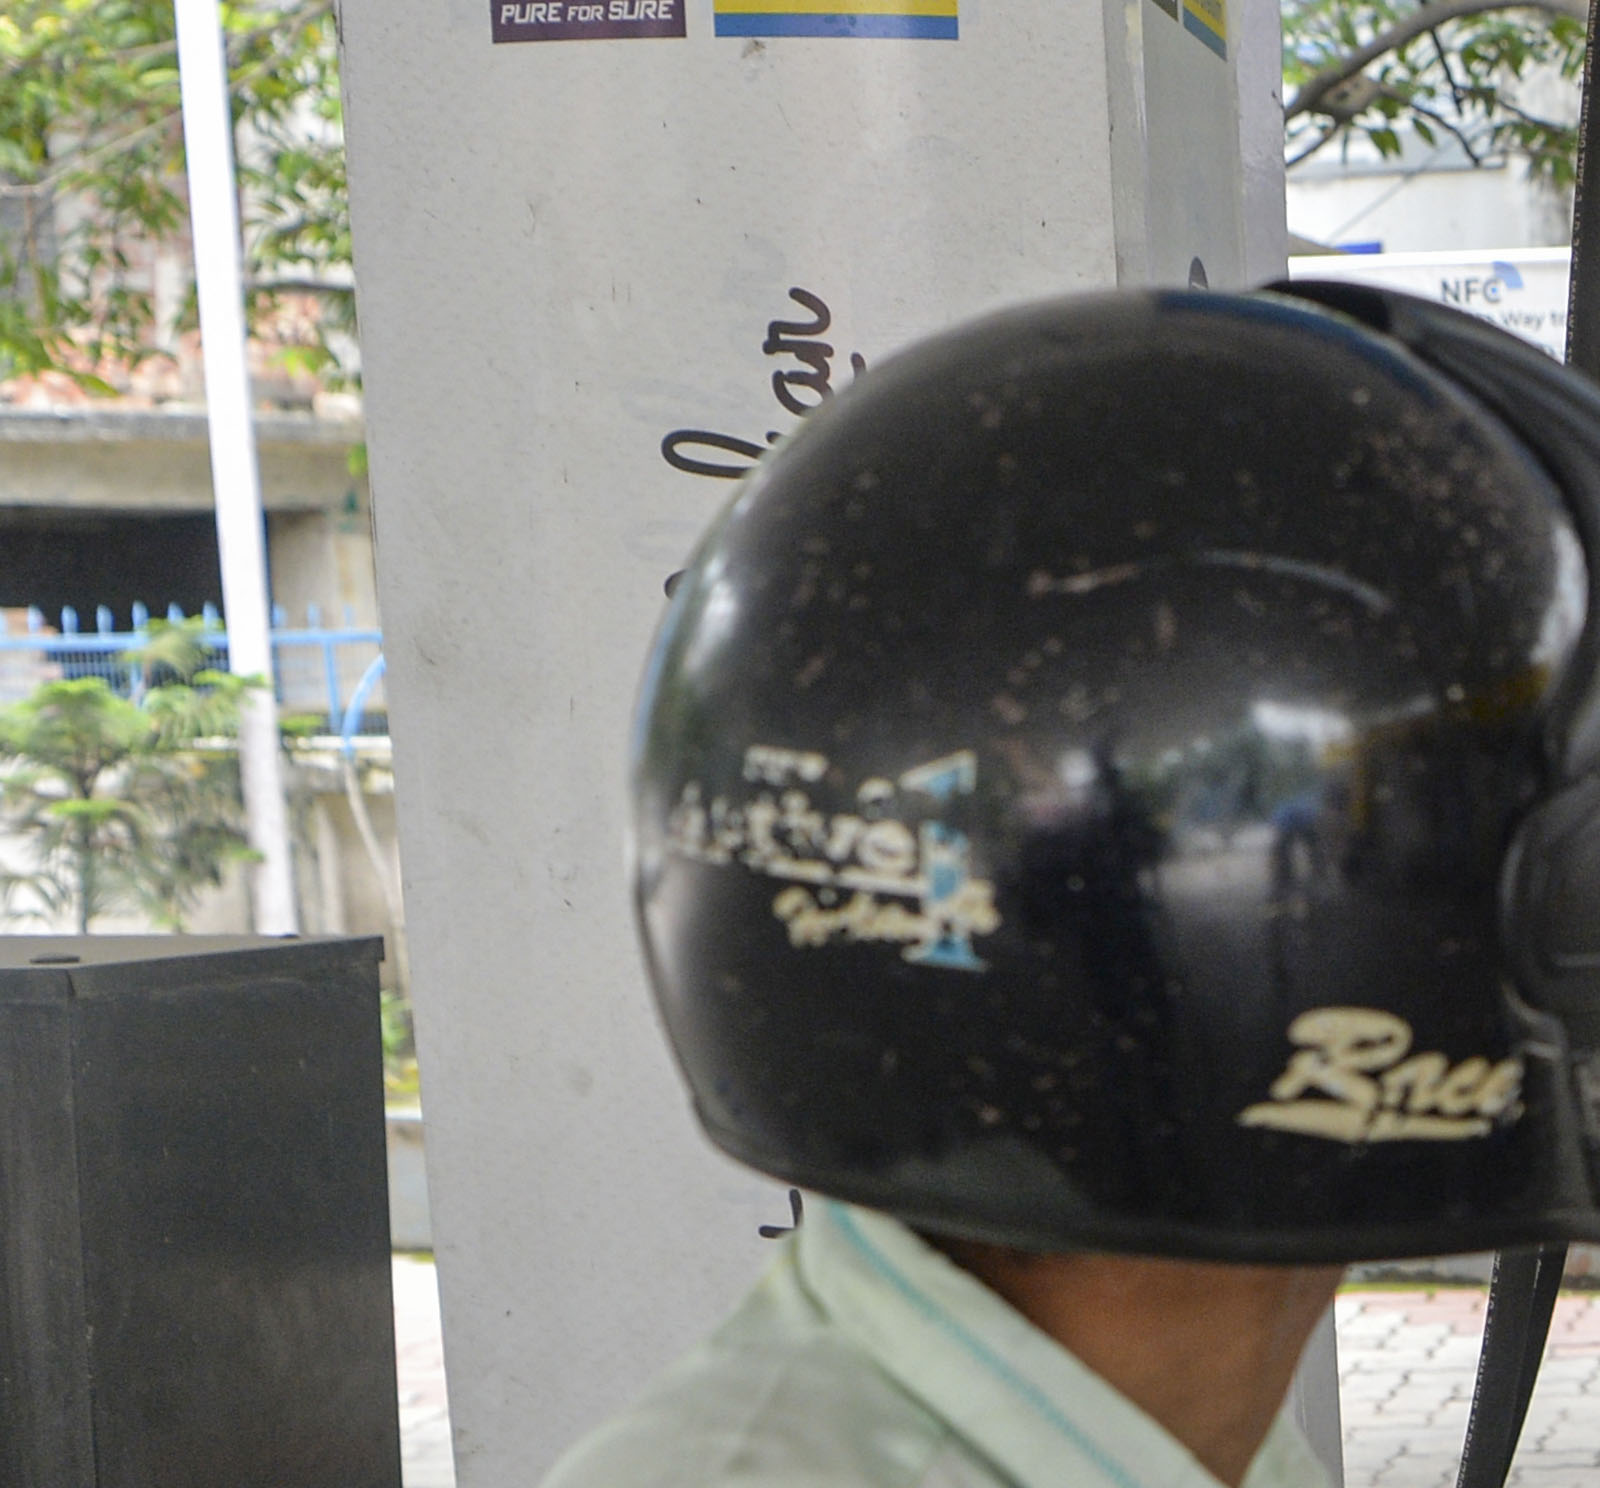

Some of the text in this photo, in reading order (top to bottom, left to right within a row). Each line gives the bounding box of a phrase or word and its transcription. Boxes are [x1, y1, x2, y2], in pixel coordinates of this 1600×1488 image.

[500, 0, 673, 24] PURE FOR SURE
[1440, 277, 1503, 303] NFC
